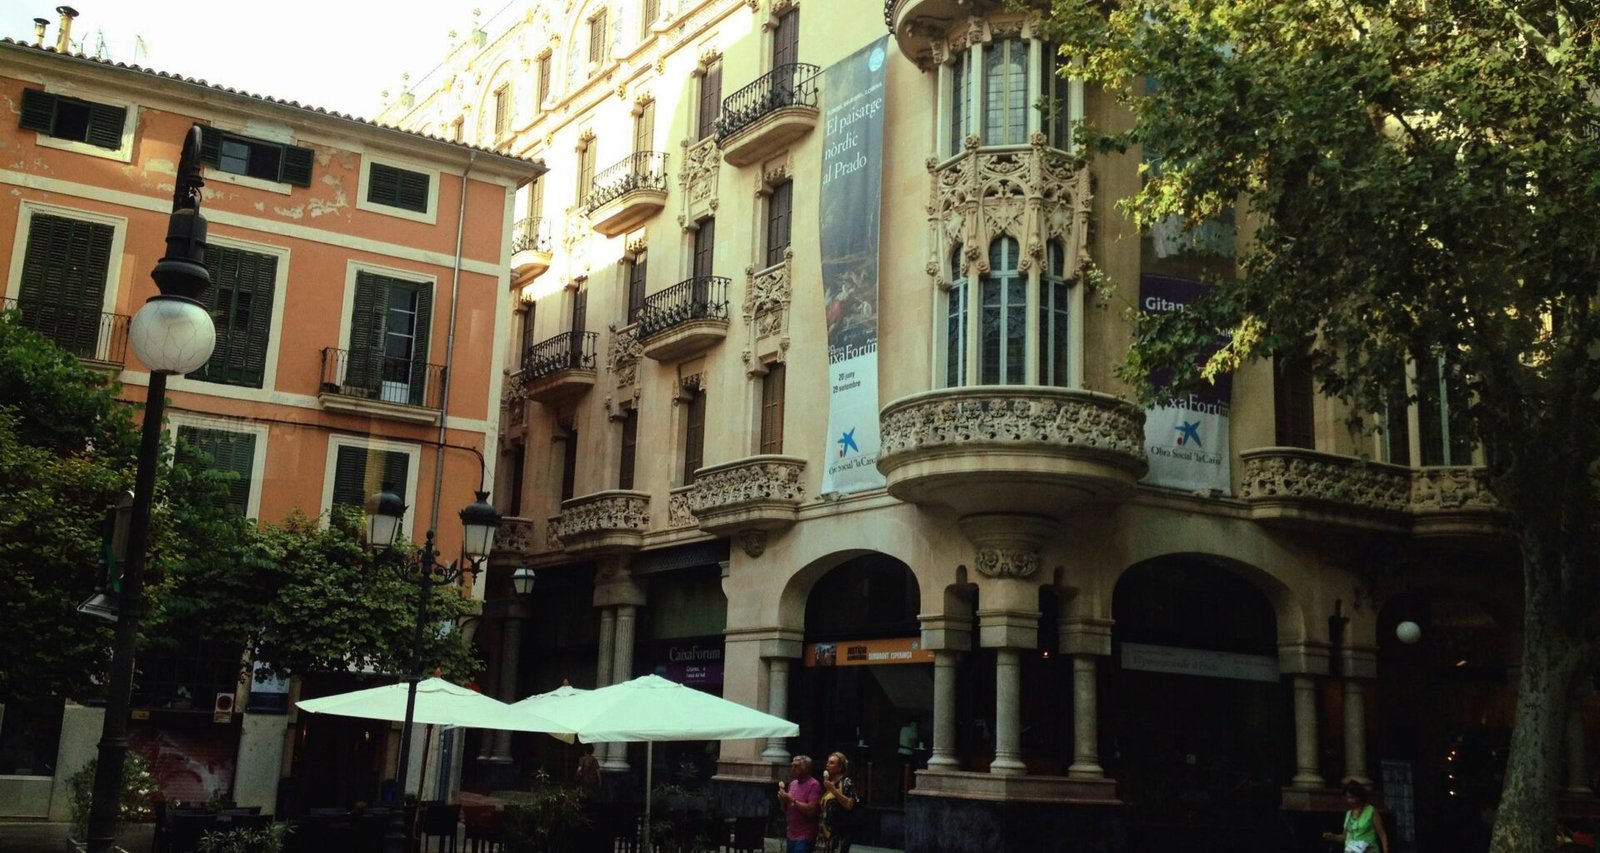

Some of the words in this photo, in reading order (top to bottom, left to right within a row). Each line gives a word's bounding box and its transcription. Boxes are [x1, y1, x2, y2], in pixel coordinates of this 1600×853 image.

[826, 115, 838, 136] El
[839, 97, 882, 134] paisatge
[825, 131, 858, 160] nòrdic
[823, 164, 832, 184] al
[834, 152, 867, 179] Prado
[1151, 446, 1171, 457] Obra
[1171, 449, 1193, 460] Social
[669, 645, 721, 662] CaixaForum
